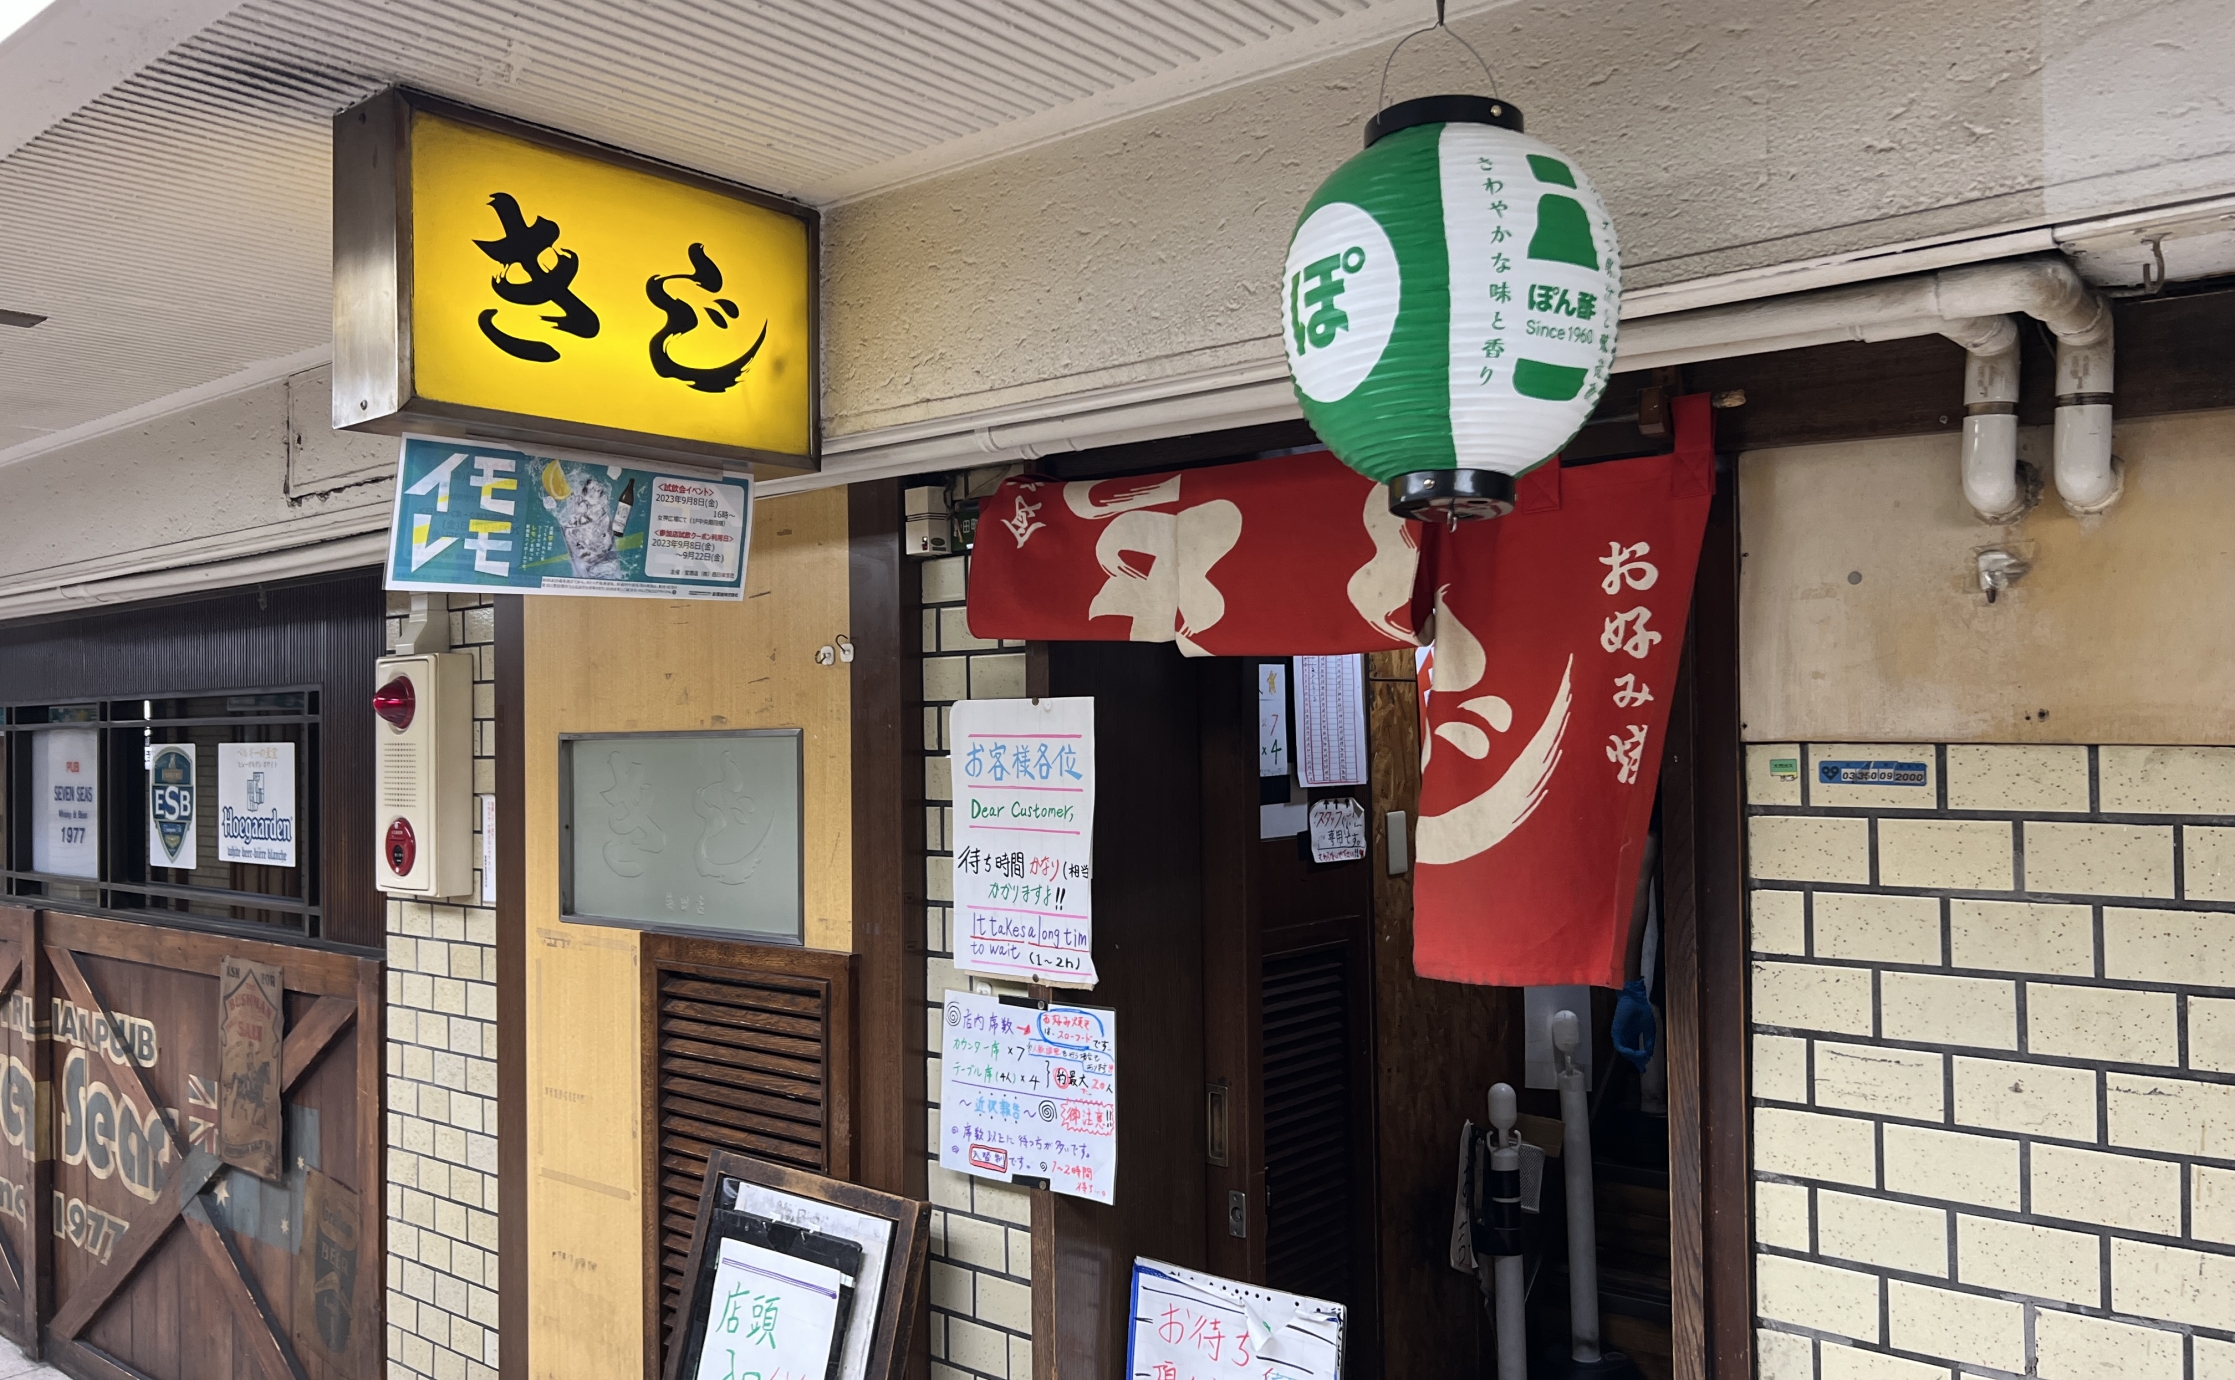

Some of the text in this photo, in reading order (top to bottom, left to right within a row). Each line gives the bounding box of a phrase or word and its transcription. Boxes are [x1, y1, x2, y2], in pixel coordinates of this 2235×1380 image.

[1477, 157, 1513, 386] さわやかな味と香り
[1290, 246, 1366, 357] ぽ
[1527, 284, 1598, 321] ぽん酢
[1525, 320, 1593, 344] Since 1960
[655, 494, 718, 509] 2023年9月8日(金)
[651, 538, 715, 552] 2023年9月8日(金)
[66, 761, 79, 773] PUB
[964, 741, 1084, 782] お客様各位
[54, 785, 93, 802] SEVEN SEAS
[154, 785, 191, 820] ESB
[970, 798, 1074, 822] Dear Customer,
[61, 826, 86, 844] 1977
[222, 805, 292, 845] Hoegaarden
[973, 912, 986, 937] It
[989, 916, 1026, 938] takes
[970, 940, 985, 955] to
[989, 942, 1021, 960] wait
[261, 972, 276, 988] FOR
[962, 1008, 1014, 1036] 店内席数
[953, 1038, 1000, 1061] カウンター席
[53, 1189, 130, 1266] 1977
[715, 1281, 781, 1350] 店頭
